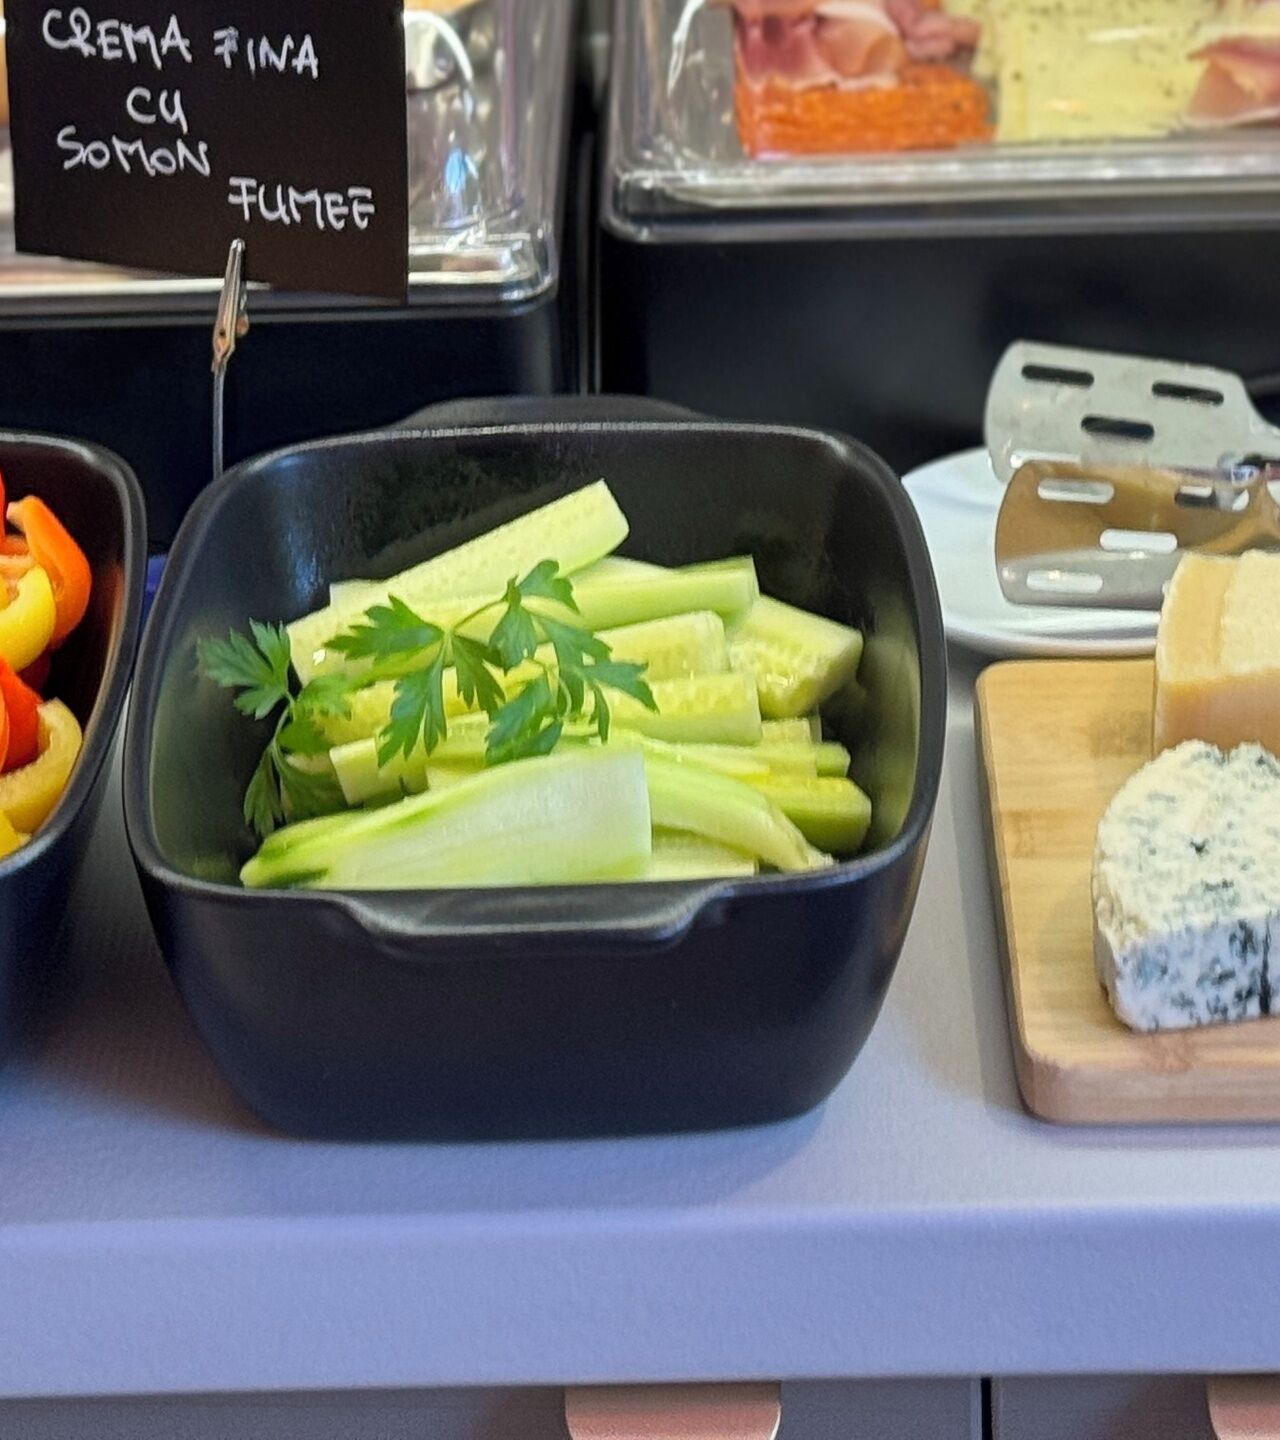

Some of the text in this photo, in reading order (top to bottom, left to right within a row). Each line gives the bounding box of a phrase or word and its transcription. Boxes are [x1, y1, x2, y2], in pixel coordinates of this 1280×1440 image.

[42, 7, 320, 79] CREMA FINA
[126, 86, 189, 134] CU
[56, 124, 211, 177] SOMON
[227, 175, 376, 230] FUMEE
